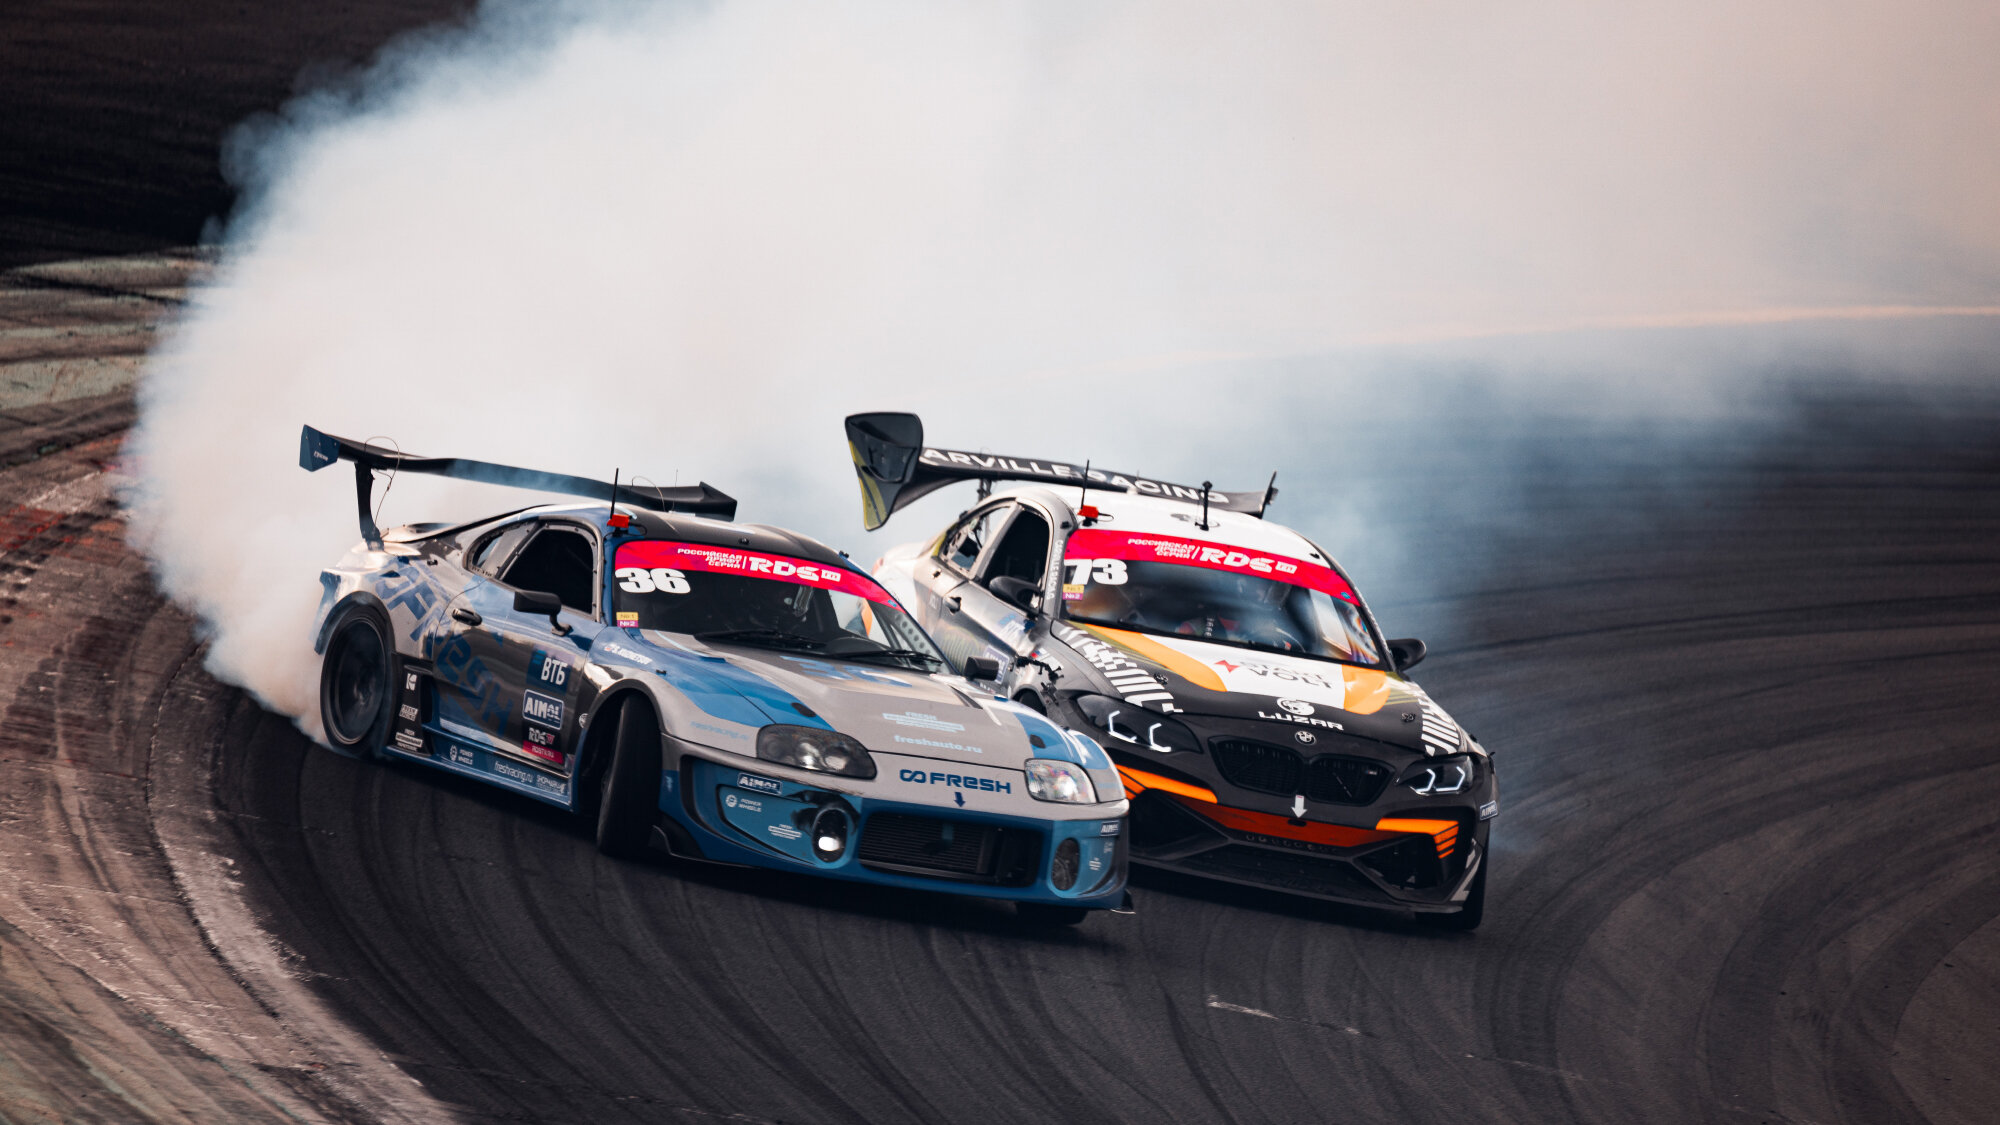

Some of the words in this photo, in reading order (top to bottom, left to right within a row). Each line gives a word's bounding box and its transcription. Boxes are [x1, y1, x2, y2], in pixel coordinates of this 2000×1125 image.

[677, 548, 743, 560] РОССИЙСКАЯ
[1128, 538, 1196, 550] РОССИЙСКАЯ
[708, 560, 741, 569] СЕРИЯ
[748, 556, 819, 582] RDS
[1199, 547, 1275, 573] RDS
[615, 567, 691, 594] 36
[1064, 558, 1128, 585] 73
[541, 657, 568, 686] ВТБ
[1258, 711, 1344, 731] LUZAR
[894, 735, 983, 754] freshauto.ru
[929, 772, 1011, 794] FRESH
